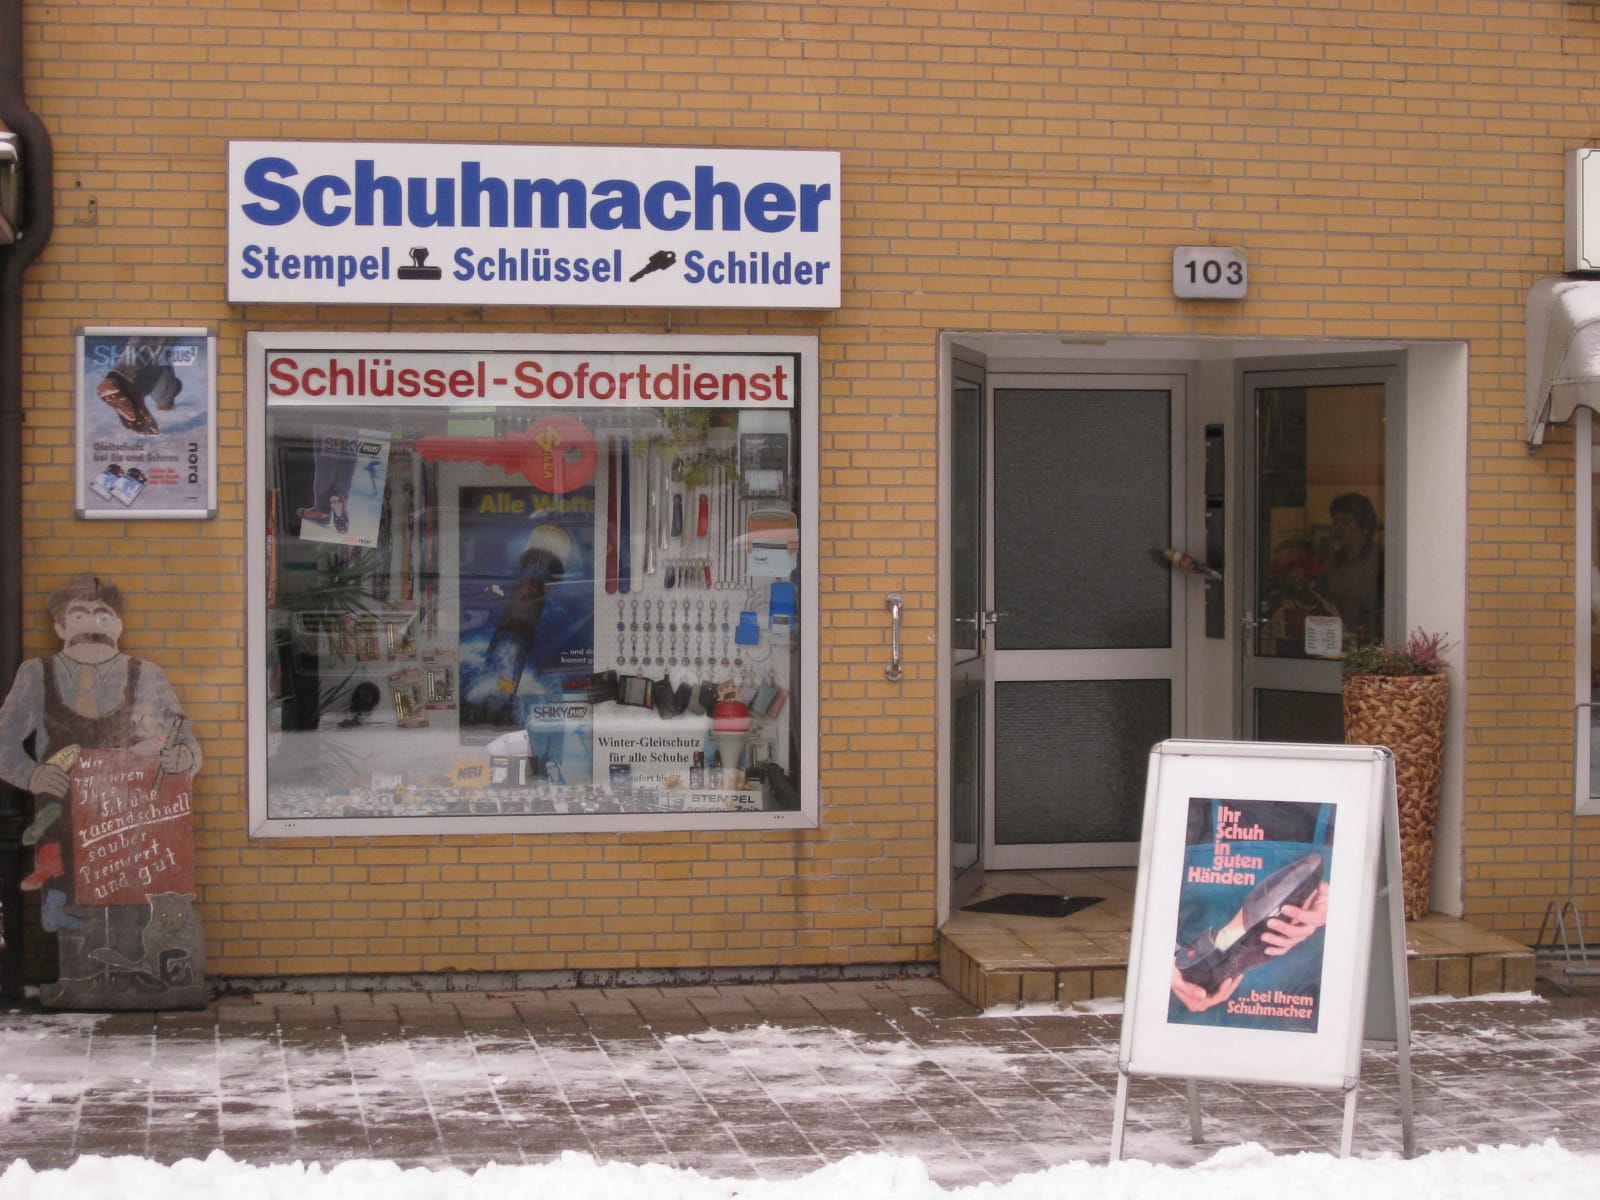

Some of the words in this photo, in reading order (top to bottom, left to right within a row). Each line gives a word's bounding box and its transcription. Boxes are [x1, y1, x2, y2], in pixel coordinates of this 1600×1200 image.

[242, 156, 831, 233] Schuhmacher
[241, 245, 390, 286] Stempel
[453, 247, 621, 283] Schlüssel
[683, 250, 830, 285] Schilder
[1185, 260, 1243, 285] 103
[188, 442, 199, 484] nora
[480, 493, 526, 513] Alle
[598, 737, 700, 748] Winter-Gleitschutz
[80, 757, 103, 768] Wir
[609, 752, 625, 763] für
[629, 753, 647, 763] alle
[651, 752, 689, 763] Schuhe
[1217, 806, 1241, 823] Ihr
[1216, 823, 1264, 840] Schuh
[1214, 840, 1230, 855] in
[139, 847, 176, 885] gut
[1213, 854, 1263, 870] guten
[1188, 867, 1255, 885] Händen
[1274, 991, 1314, 1006] Ihrem
[1227, 1000, 1312, 1018] Schuhmacher
